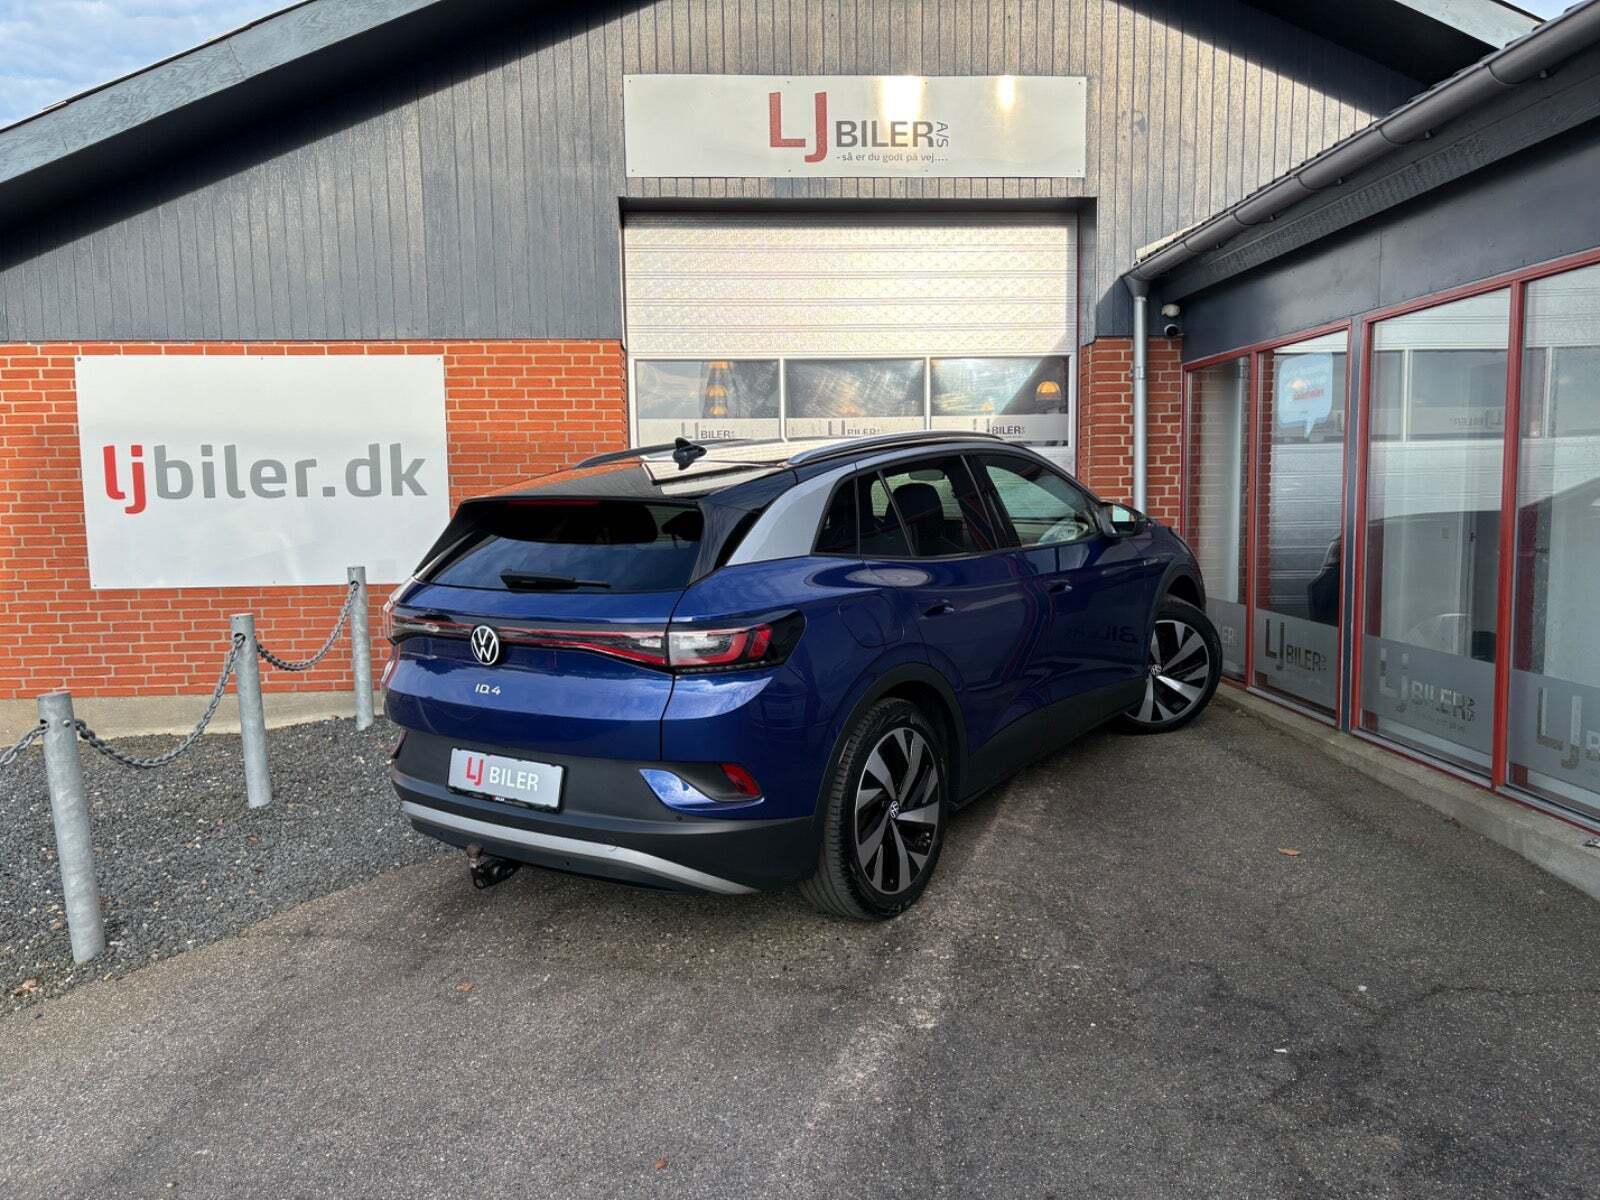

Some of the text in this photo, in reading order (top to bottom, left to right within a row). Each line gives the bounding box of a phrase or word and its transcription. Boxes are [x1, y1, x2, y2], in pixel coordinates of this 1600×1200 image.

[769, 92, 828, 163] LJ
[836, 120, 934, 148] BILER
[855, 153, 865, 161] er
[868, 152, 880, 161] du
[881, 152, 903, 163] godt
[906, 152, 918, 163] på
[102, 442, 427, 515] ljbiler.dk
[1285, 643, 1321, 672] BILER
[466, 756, 539, 791] LJ BILER
